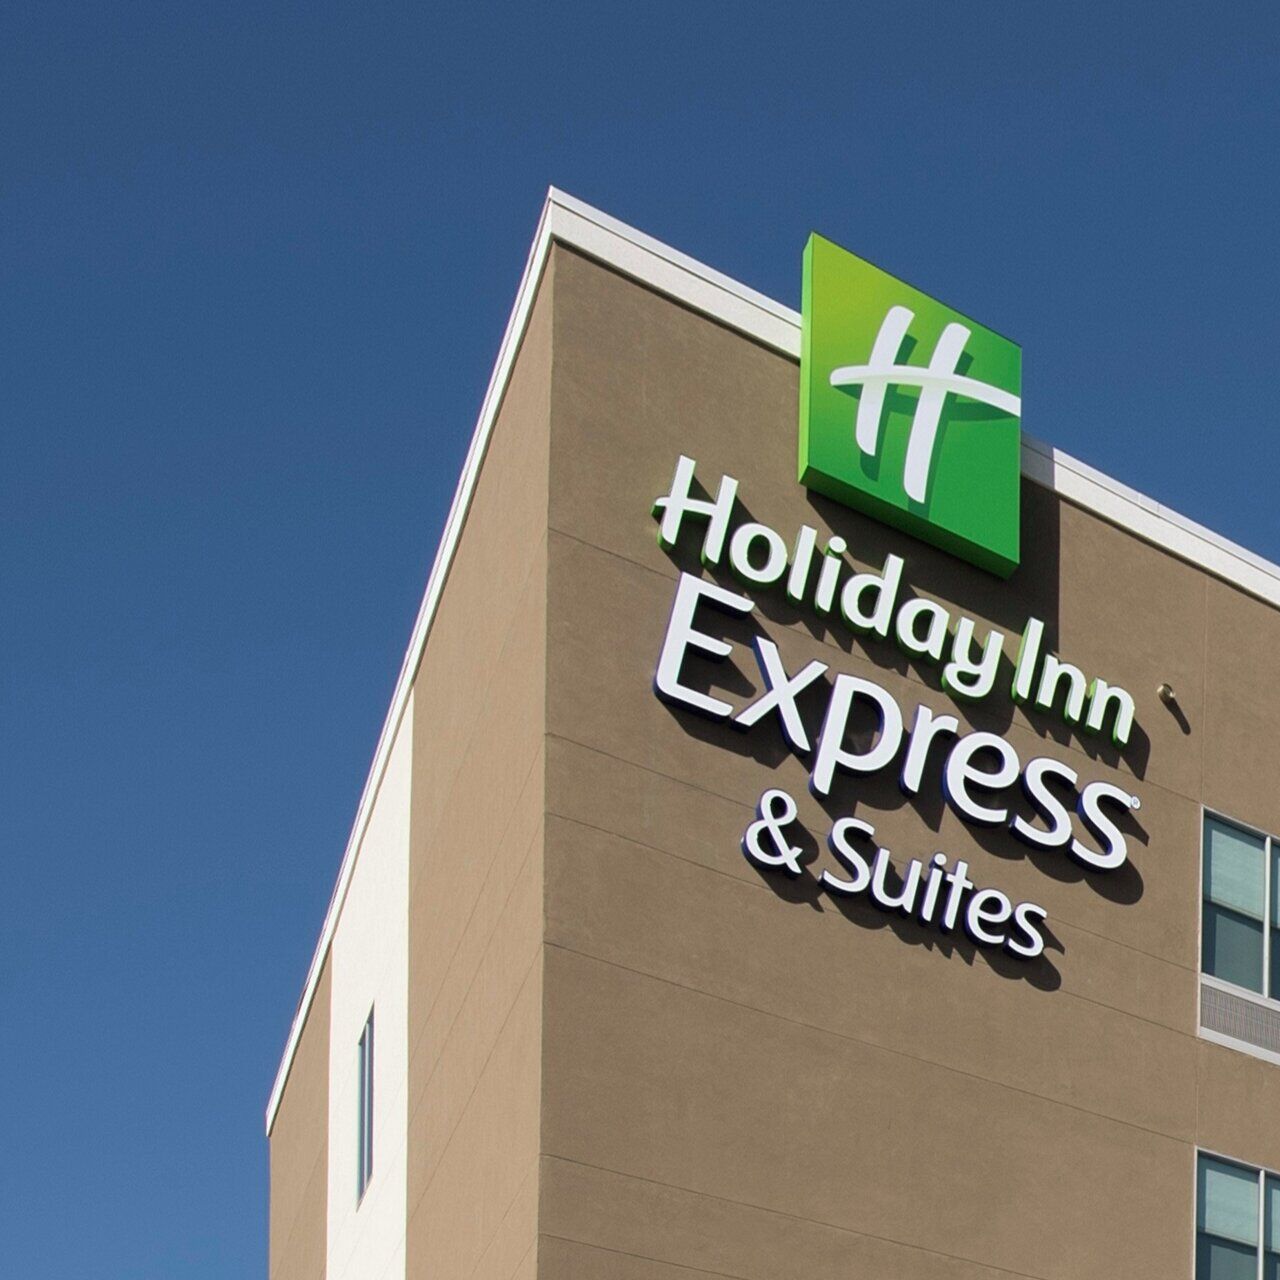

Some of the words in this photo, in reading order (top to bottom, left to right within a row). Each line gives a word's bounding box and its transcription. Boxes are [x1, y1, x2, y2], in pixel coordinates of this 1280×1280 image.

[652, 454, 1005, 701] Holiday
[1011, 616, 1136, 750] Inn
[741, 788, 804, 879] &
[818, 816, 1048, 960] Suites
